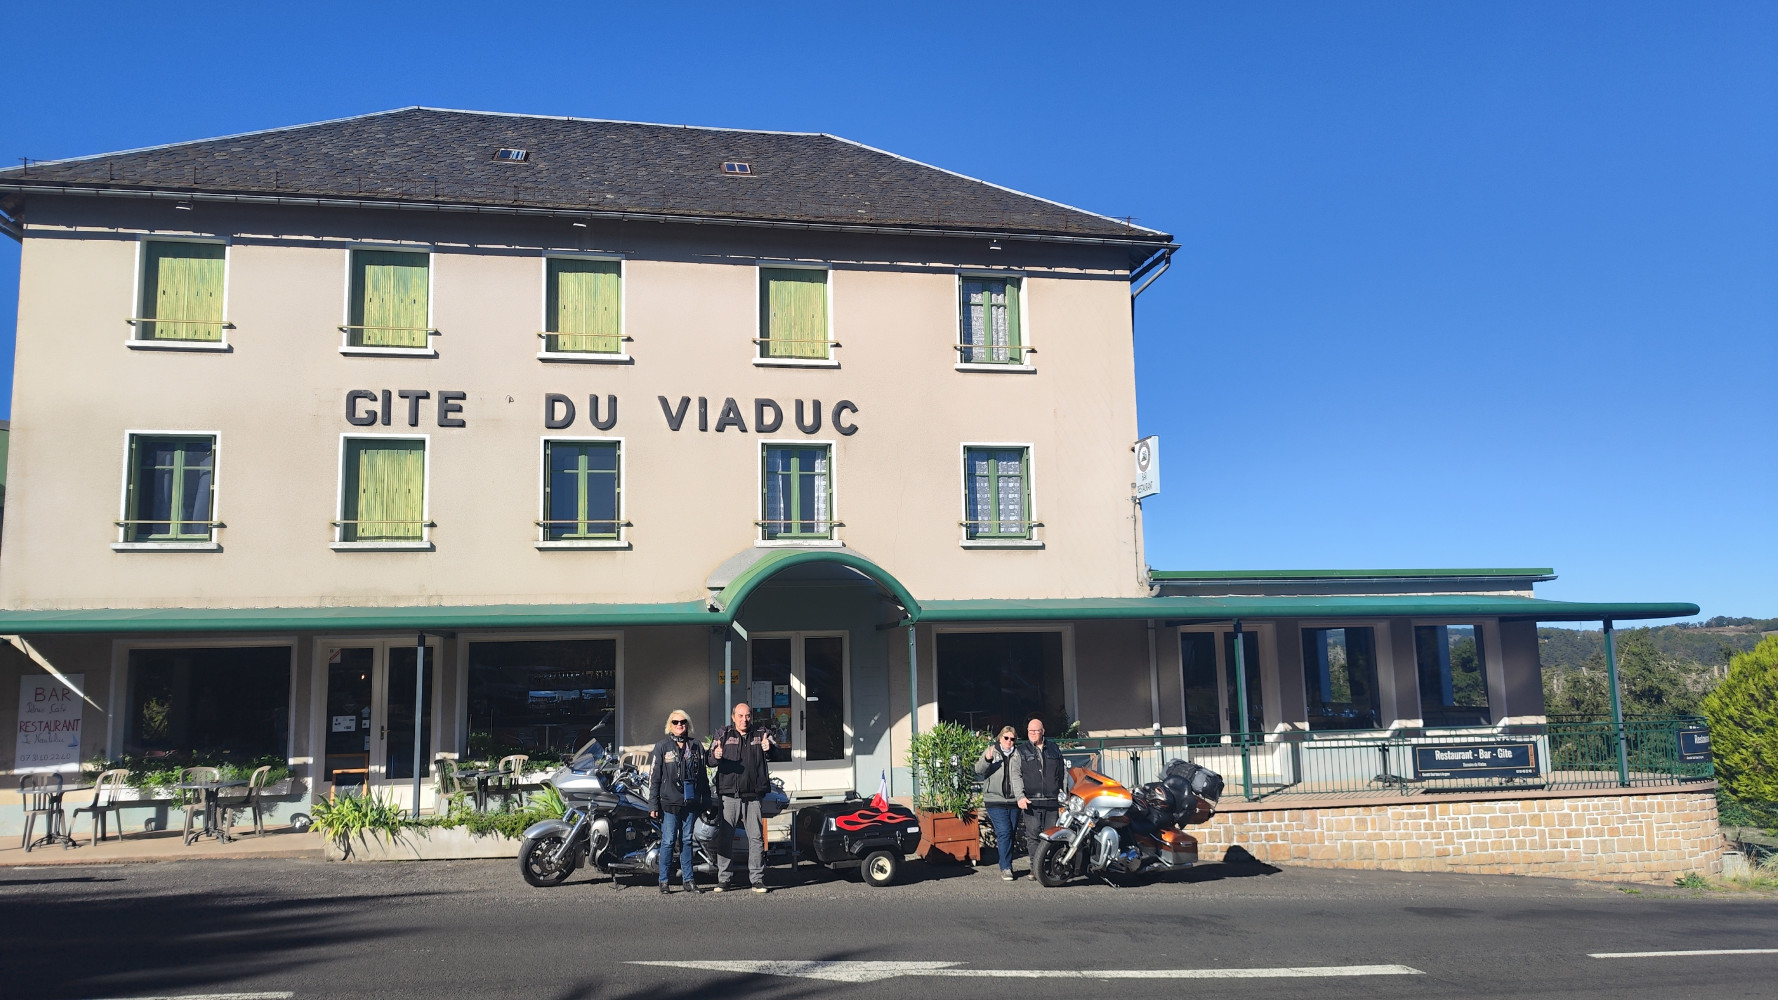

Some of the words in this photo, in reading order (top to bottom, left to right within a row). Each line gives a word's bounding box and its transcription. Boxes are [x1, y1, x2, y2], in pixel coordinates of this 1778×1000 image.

[346, 389, 466, 428] GITE
[544, 393, 618, 431] DU
[657, 395, 859, 436] VIADUC
[34, 687, 71, 702] BAR
[19, 718, 81, 733] RESTAURANT
[1435, 749, 1473, 761] Restaurant
[1478, 748, 1491, 759] Bar
